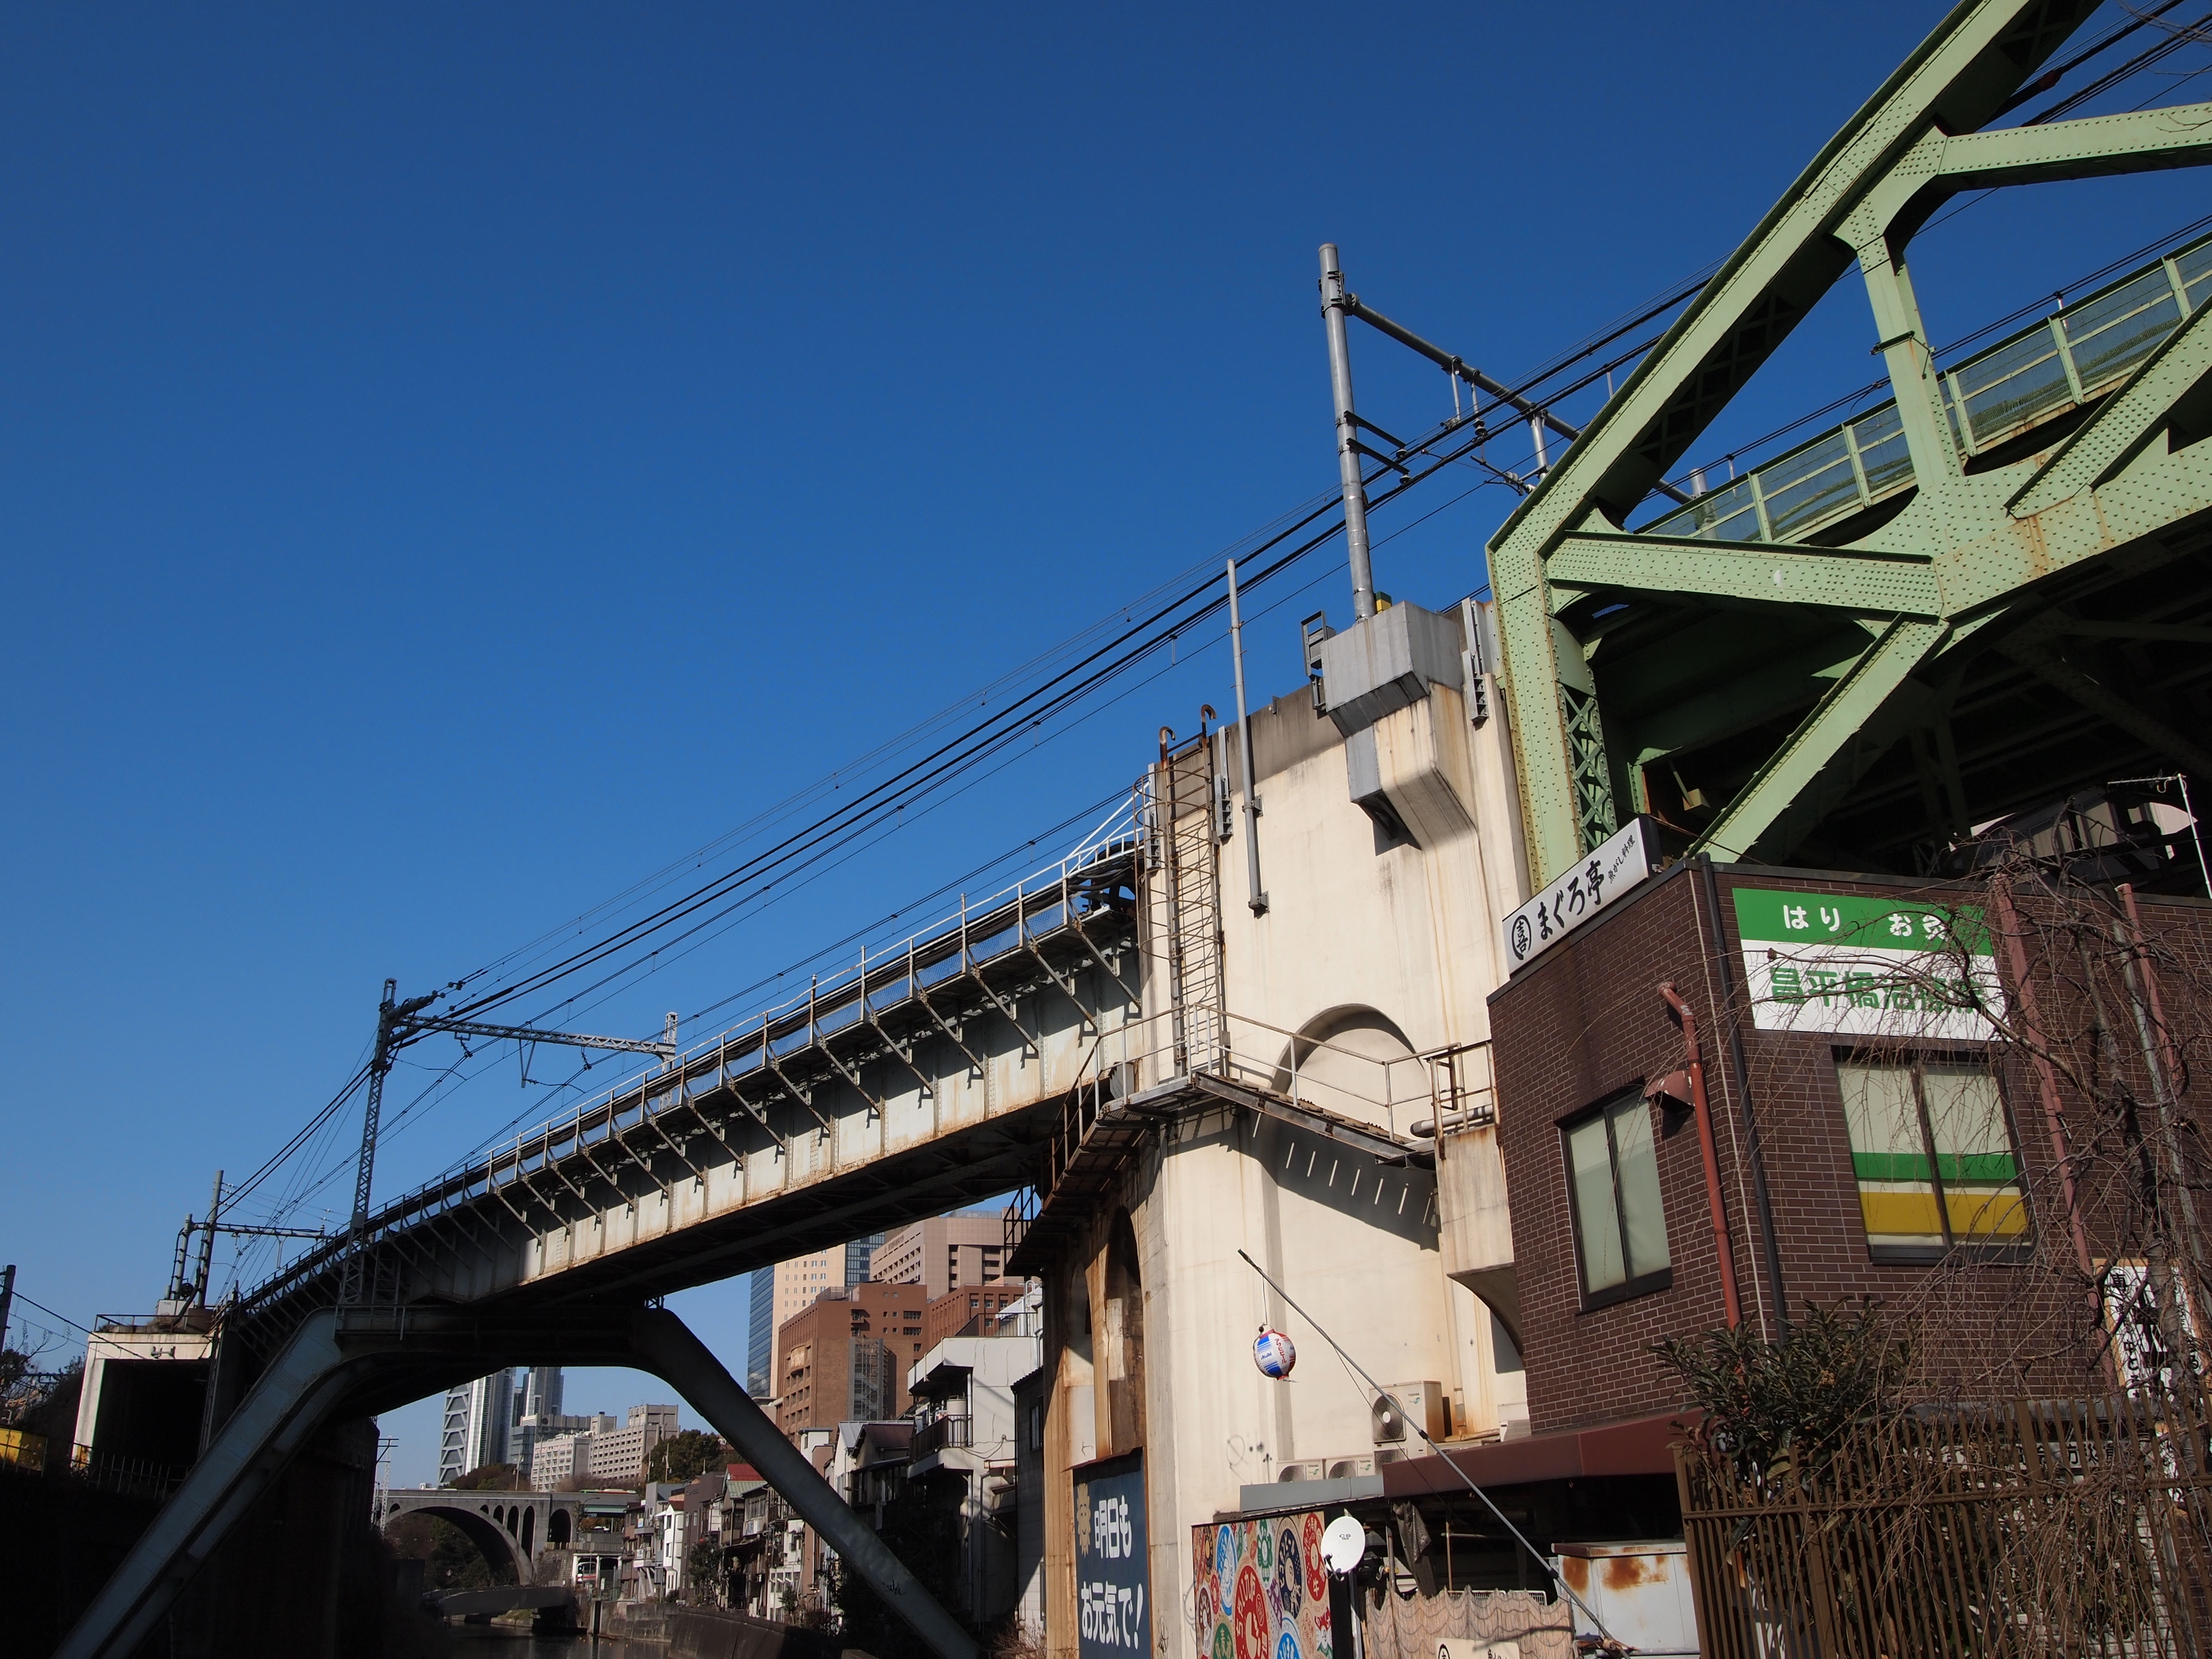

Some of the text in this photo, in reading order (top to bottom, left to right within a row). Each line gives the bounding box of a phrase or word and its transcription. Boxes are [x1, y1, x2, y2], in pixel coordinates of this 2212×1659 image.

[1538, 860, 1605, 940] まぐろ亭
[1783, 905, 1840, 932] はり
[1094, 1494, 1132, 1559] 明日も
[1081, 1580, 1143, 1650] お元気で!
